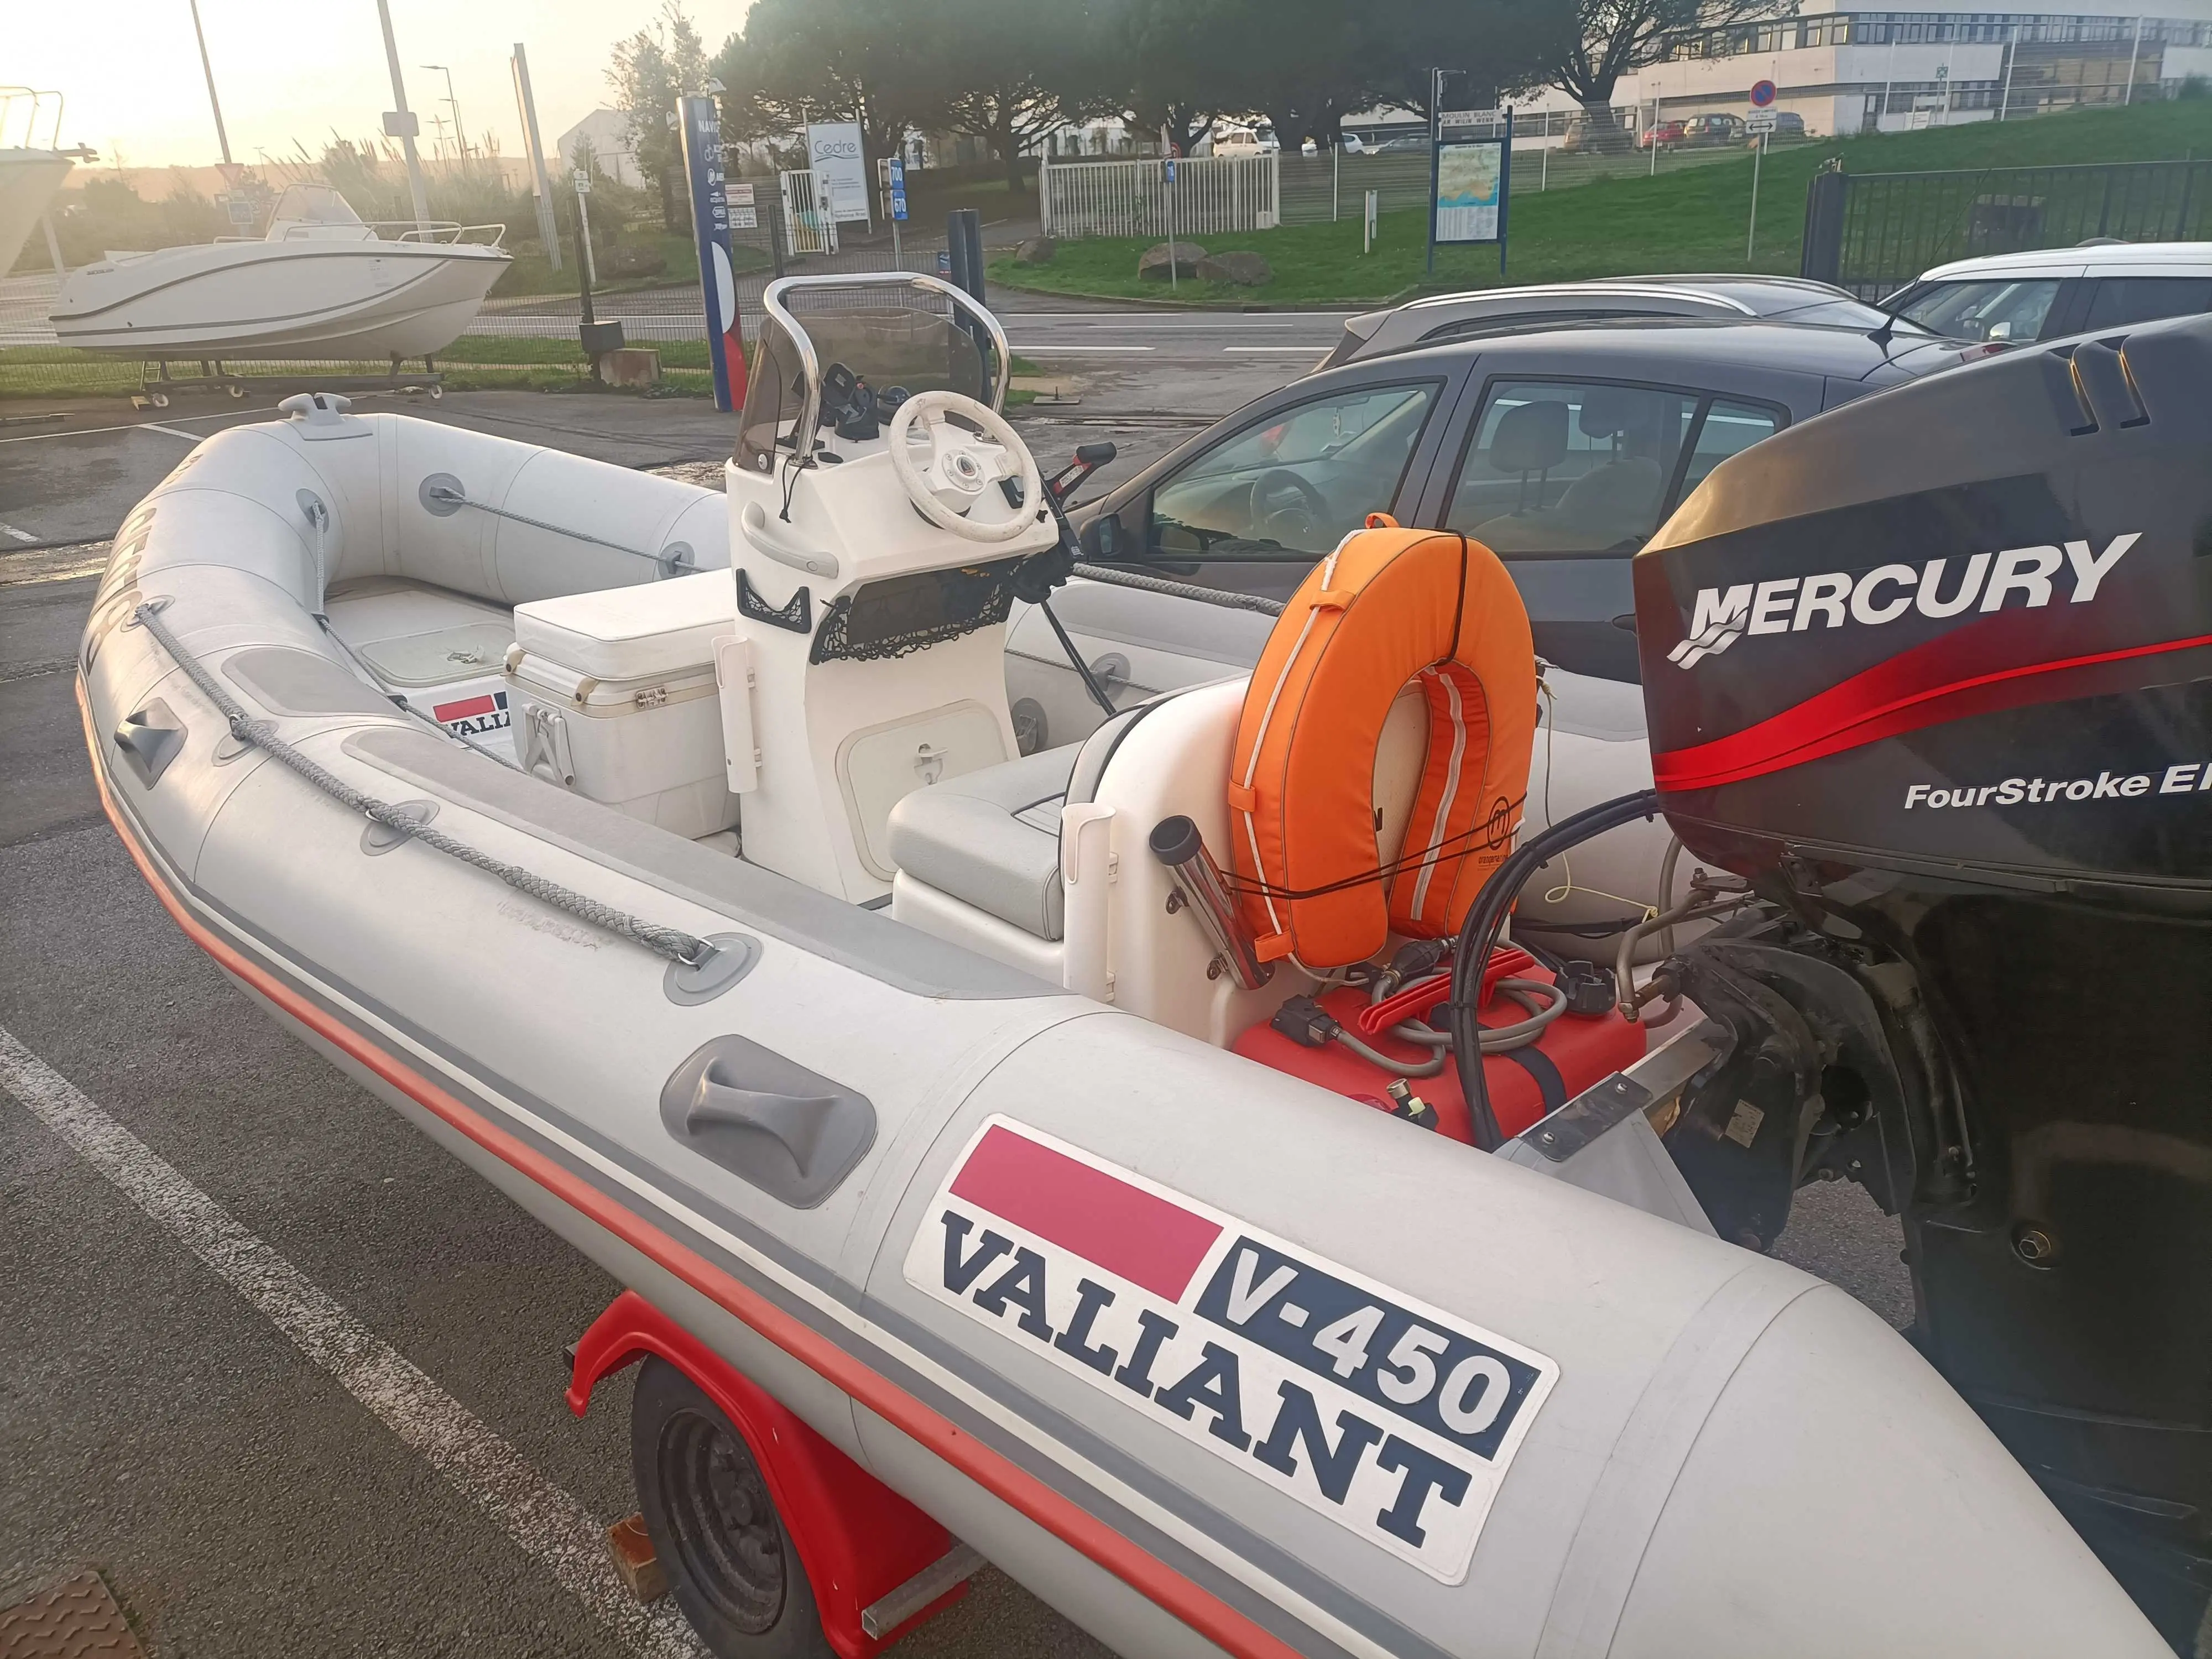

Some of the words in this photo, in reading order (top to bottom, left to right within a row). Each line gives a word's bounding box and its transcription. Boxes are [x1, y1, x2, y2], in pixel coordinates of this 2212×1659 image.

[815, 140, 857, 154] Cedre
[891, 166, 903, 181] 700
[894, 198, 906, 212] 670
[1690, 532, 2143, 640] MERCURY
[1904, 771, 2150, 809] FourStroke
[1225, 1248, 1511, 1434] V-450
[941, 1209, 1473, 1549] VALIANT
